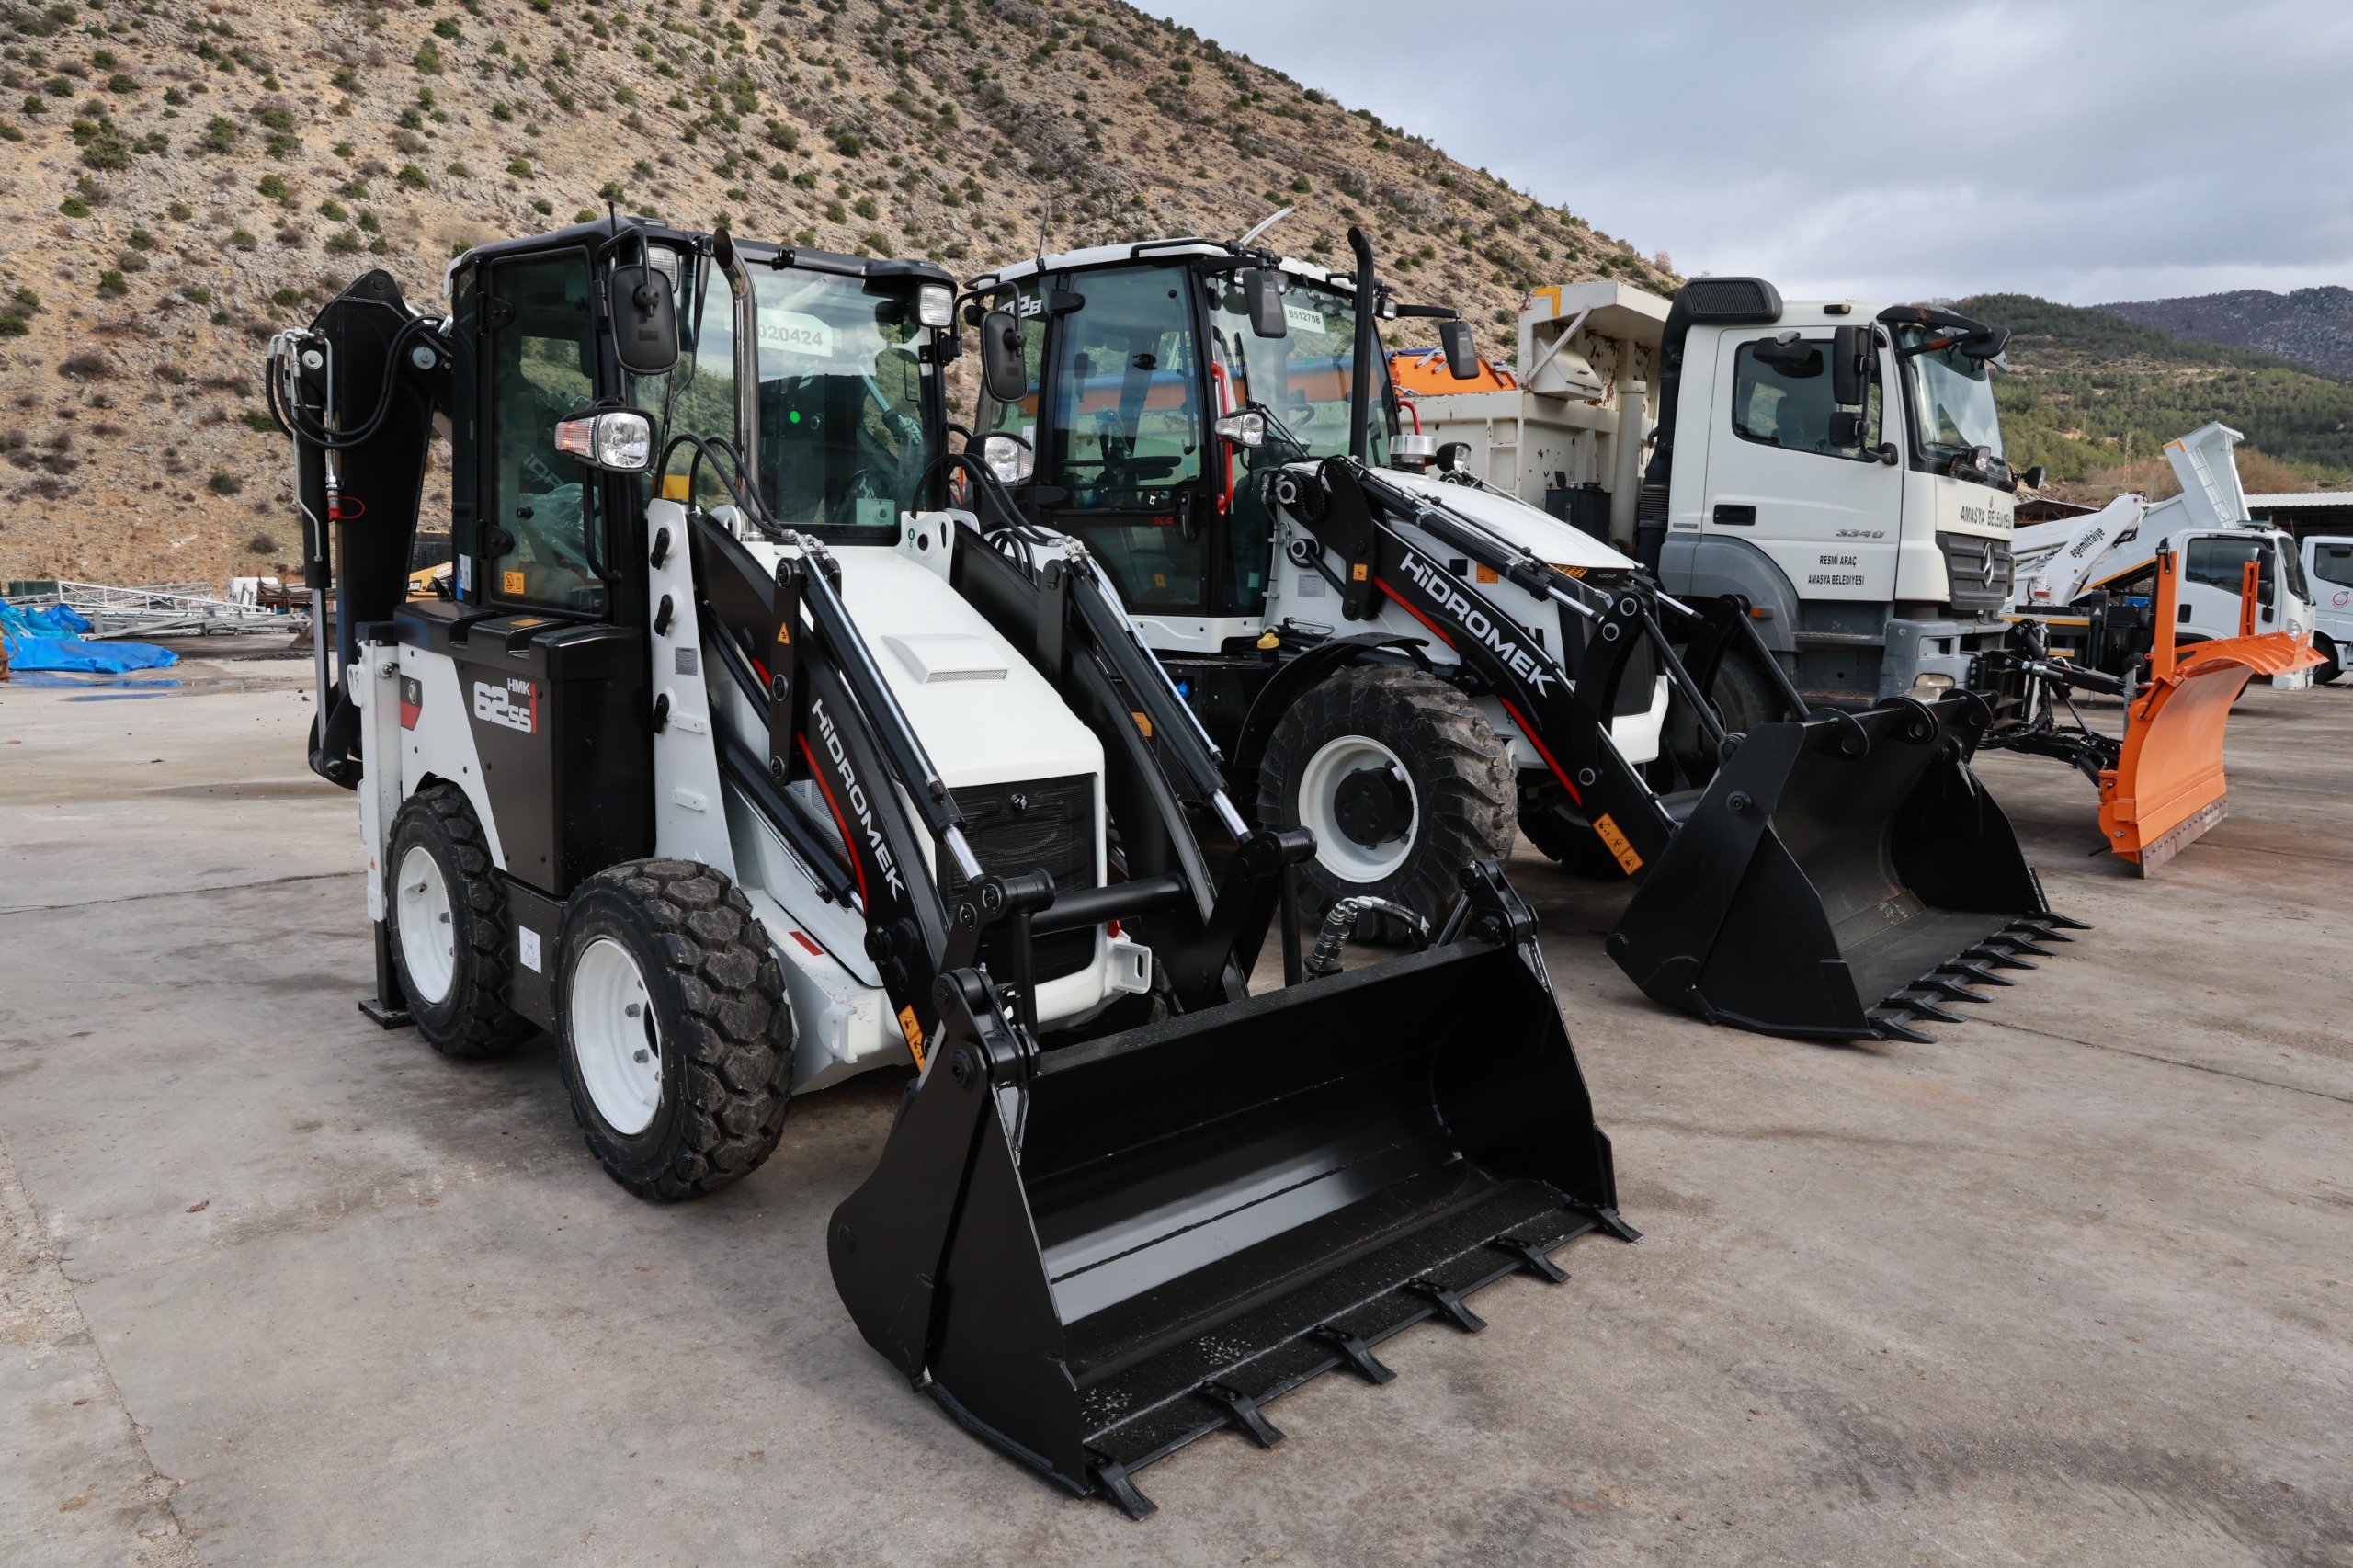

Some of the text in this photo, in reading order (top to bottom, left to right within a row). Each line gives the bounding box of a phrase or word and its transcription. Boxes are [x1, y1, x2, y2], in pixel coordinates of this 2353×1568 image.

[1289, 309, 1321, 324] B512708
[1839, 555, 1858, 569] ARAÇ
[1807, 574, 1831, 585] AMASYA
[507, 677, 530, 696] HMK
